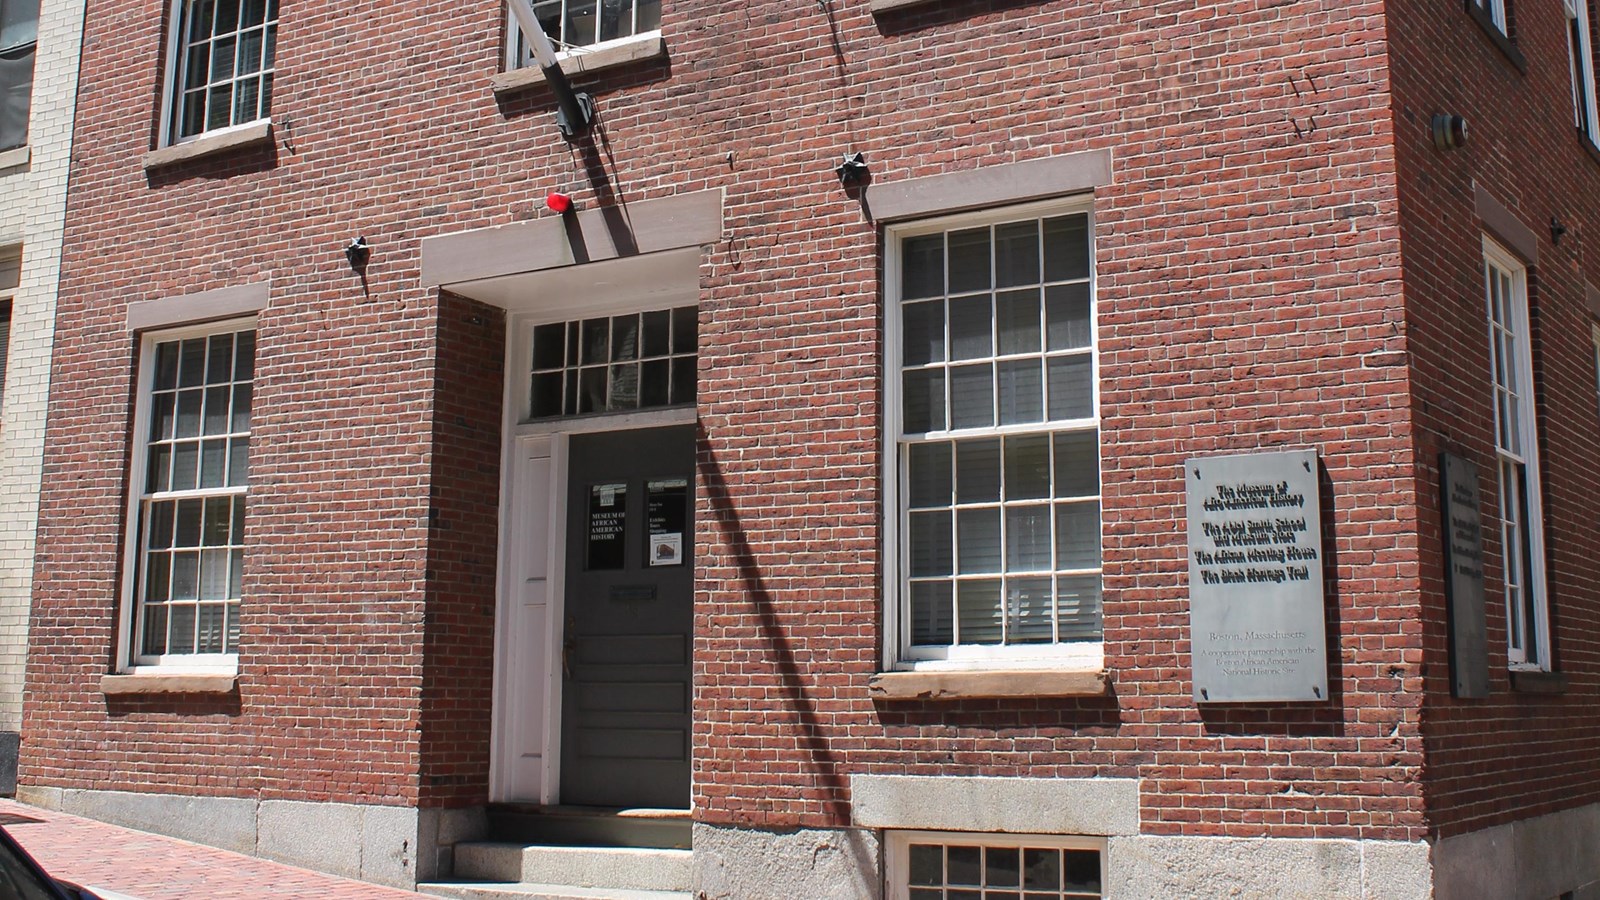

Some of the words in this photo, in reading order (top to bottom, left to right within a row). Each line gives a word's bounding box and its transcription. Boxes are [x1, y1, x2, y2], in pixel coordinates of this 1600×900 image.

[1216, 485, 1235, 499] The
[1236, 483, 1275, 498] Museum
[1276, 481, 1288, 495] of
[1269, 493, 1304, 509] History
[1202, 521, 1221, 536] The
[1221, 520, 1246, 535] Abiel
[1247, 518, 1274, 533] Smith
[1275, 516, 1307, 532] School
[1213, 532, 1231, 548] and
[1231, 531, 1271, 546] Museum
[1271, 529, 1296, 544] Store
[1194, 550, 1213, 565] The
[1213, 549, 1246, 564] African
[1246, 547, 1286, 563] Meeting
[1286, 545, 1317, 560] House
[1201, 569, 1220, 584] The
[1221, 568, 1246, 583] Black
[1246, 567, 1286, 583] Heritage
[1286, 565, 1309, 580] Trail
[1209, 631, 1243, 641] Boston,
[1245, 630, 1306, 640] Massachusetts
[1208, 648, 1247, 658] cooperative
[1247, 646, 1286, 656] partnership
[1304, 646, 1317, 654] the
[1216, 658, 1240, 666] Boston
[1241, 657, 1266, 666] African
[1266, 656, 1300, 665] American
[1223, 667, 1252, 676] National
[1253, 666, 1281, 675] Historic
